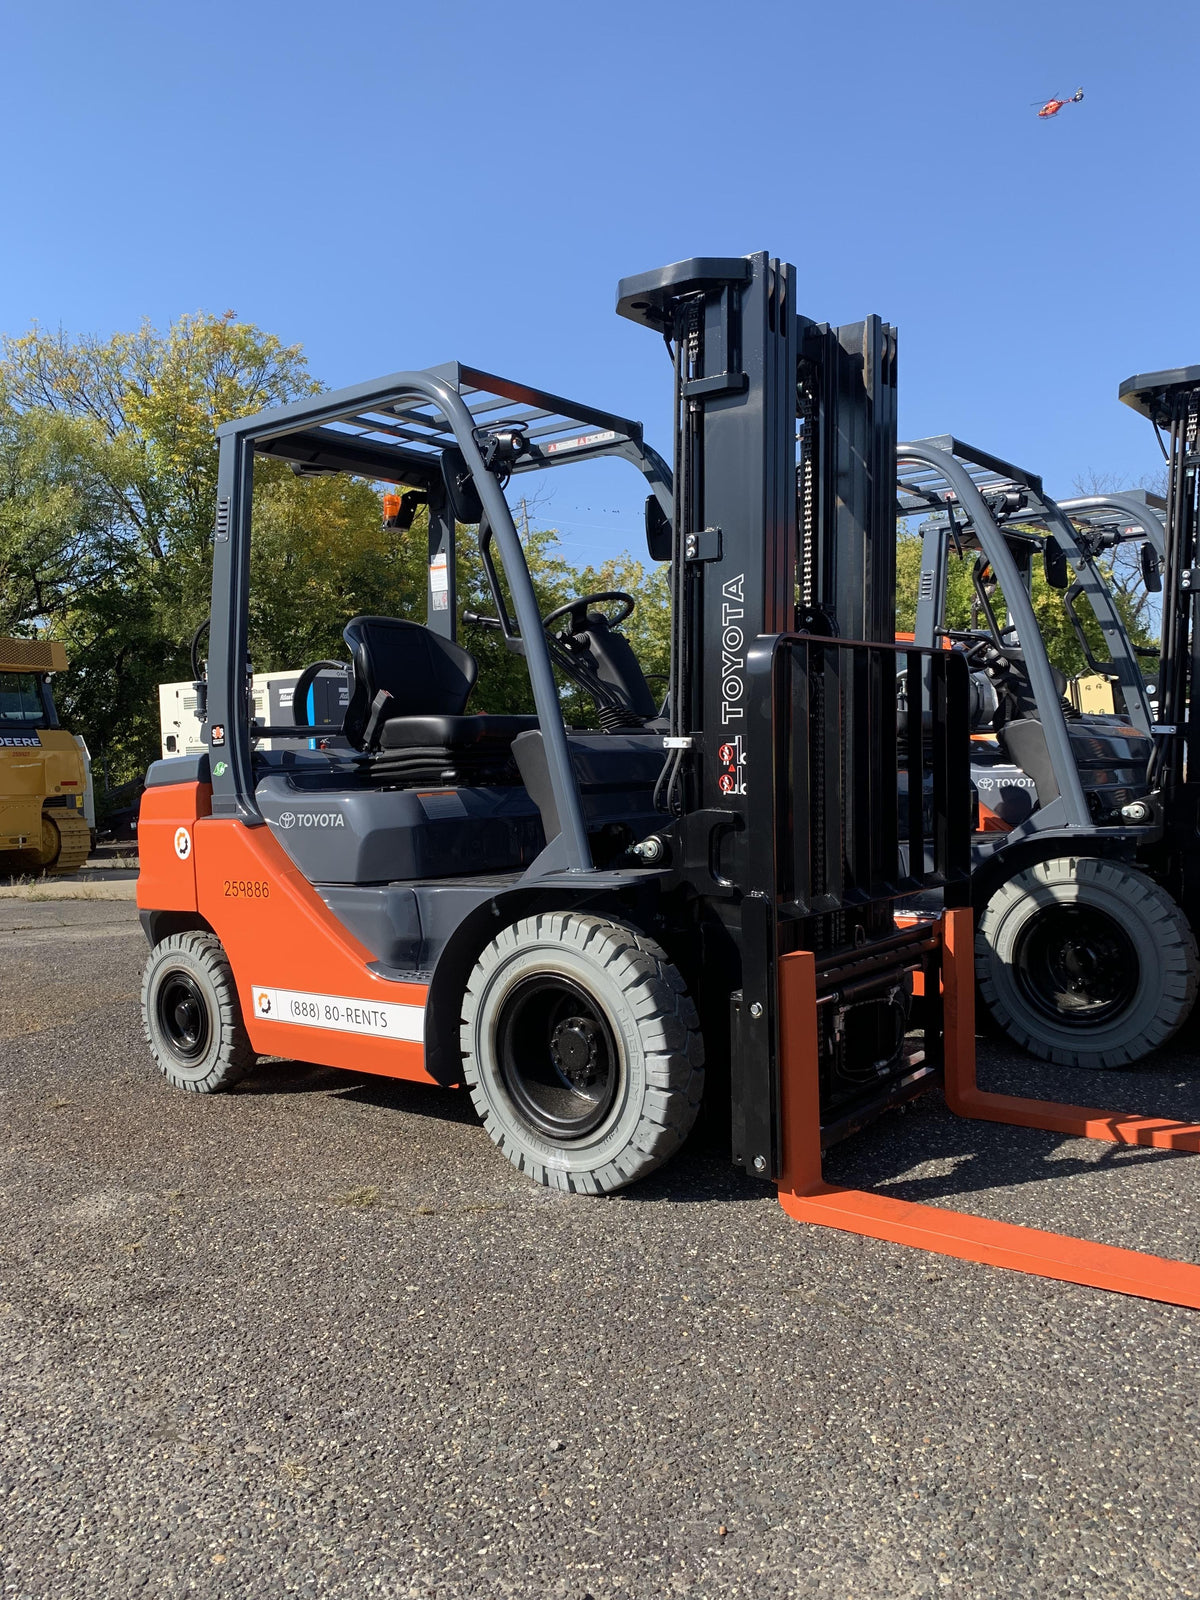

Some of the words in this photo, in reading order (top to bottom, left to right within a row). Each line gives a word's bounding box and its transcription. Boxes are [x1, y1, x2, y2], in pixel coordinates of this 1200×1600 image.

[721, 573, 744, 725] TOYOTA
[297, 813, 345, 827] TOYOTA
[224, 880, 270, 898] 259886
[290, 999, 320, 1021] (888)
[324, 1005, 388, 1028] 80-RENTS
